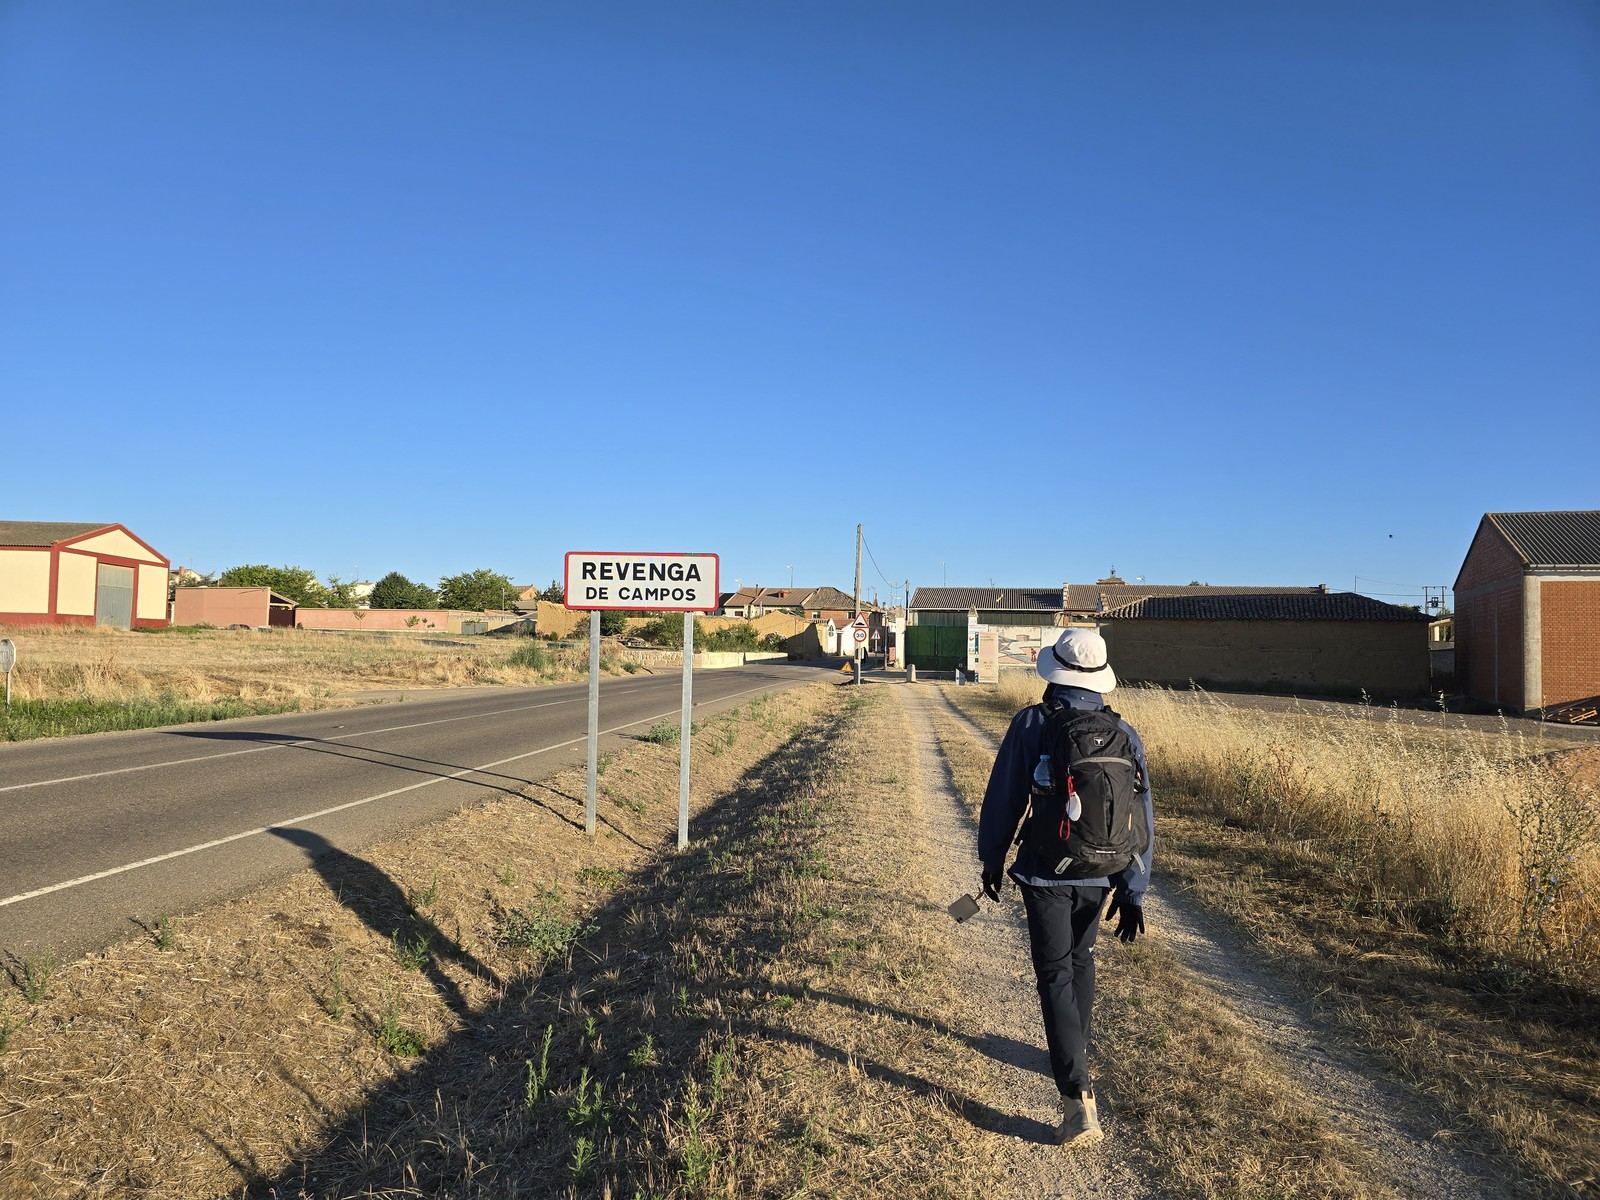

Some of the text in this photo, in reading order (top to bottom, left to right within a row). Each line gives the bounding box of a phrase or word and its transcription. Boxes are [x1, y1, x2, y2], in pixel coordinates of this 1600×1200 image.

[582, 562, 702, 582] REVENGA
[585, 587, 696, 601] DE CAMPOS
